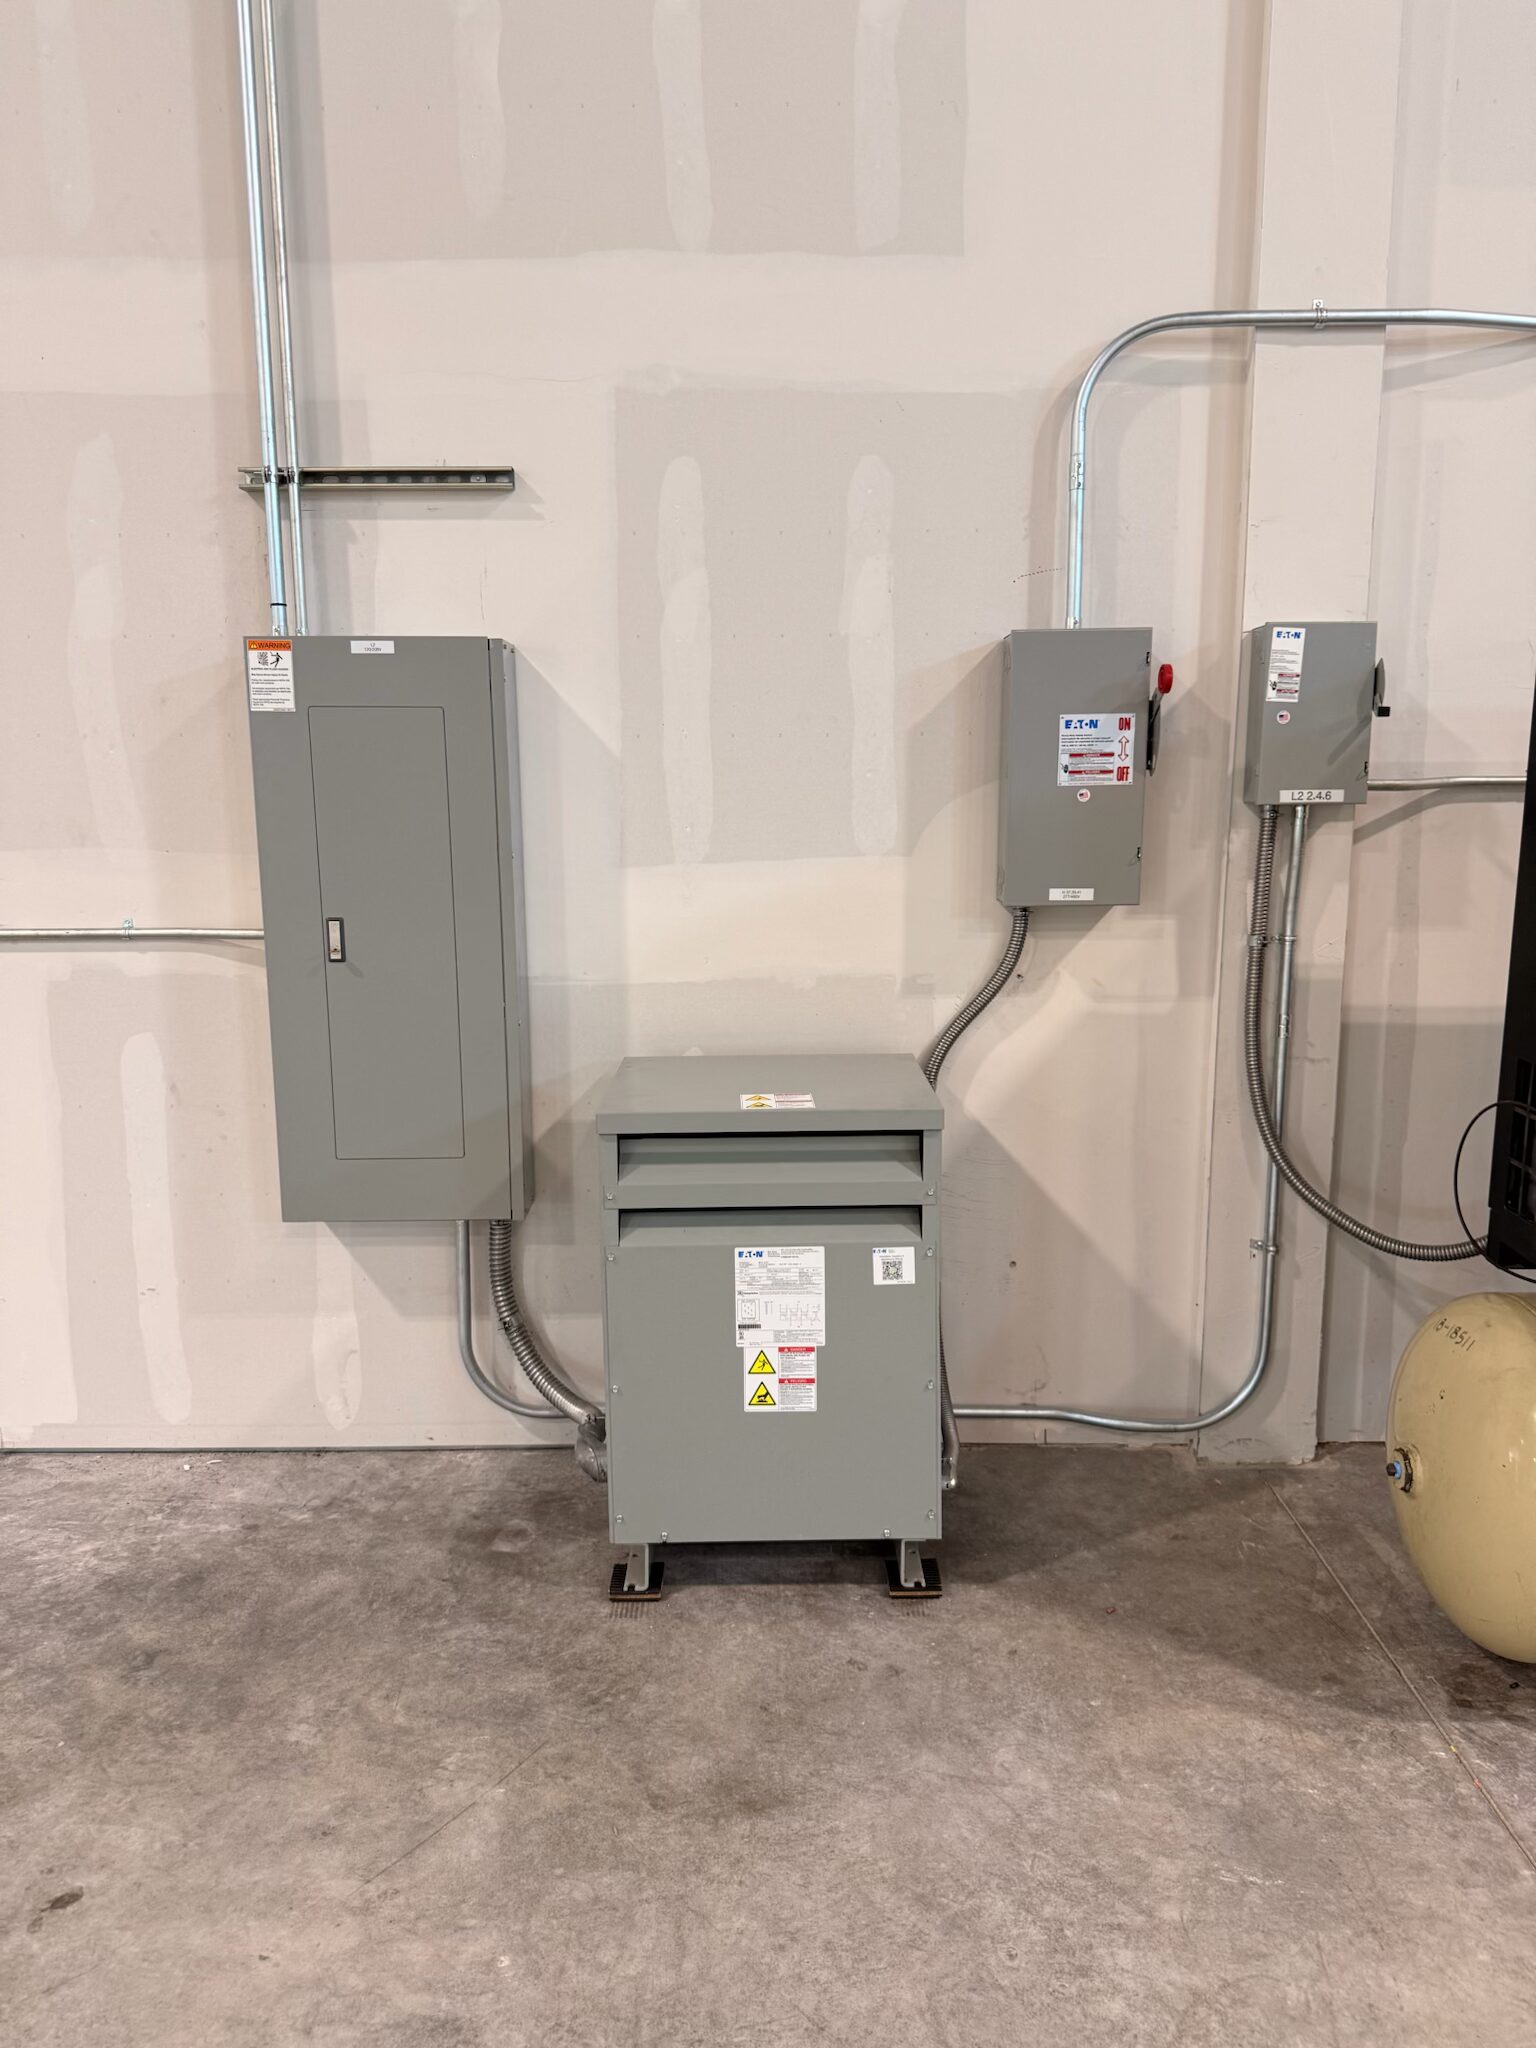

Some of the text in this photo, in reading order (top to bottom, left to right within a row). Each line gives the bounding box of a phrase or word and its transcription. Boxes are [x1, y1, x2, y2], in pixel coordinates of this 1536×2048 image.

[1064, 719, 1099, 729] EATON
[1118, 717, 1131, 731] ON
[1116, 766, 1130, 781] OFF
[1291, 791, 1304, 801] L2
